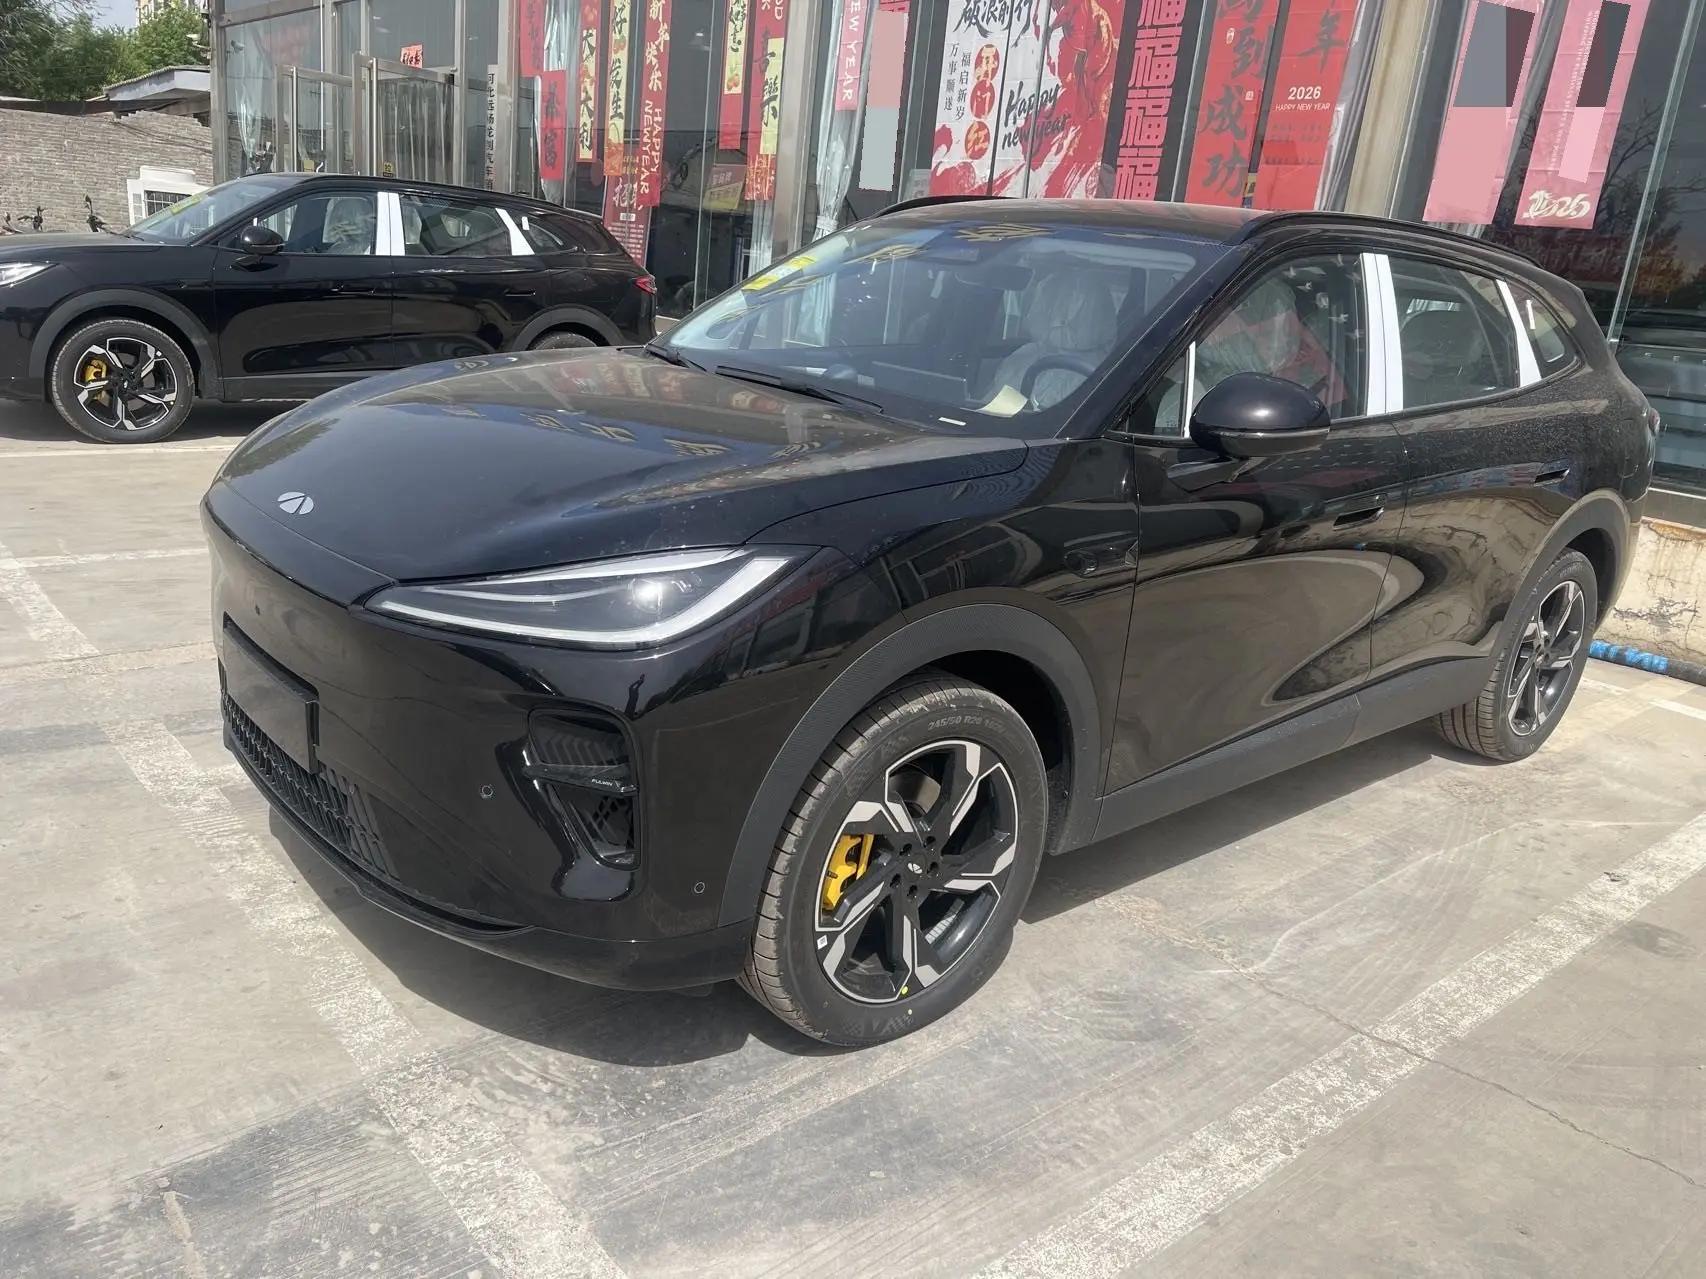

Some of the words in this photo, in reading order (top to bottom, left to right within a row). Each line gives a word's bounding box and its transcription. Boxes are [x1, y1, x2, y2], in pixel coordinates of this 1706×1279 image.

[842, 40, 858, 101] YEAR
[955, 52, 972, 121] 福启新岁
[1288, 86, 1322, 100] 2026
[1004, 81, 1061, 127] Happy
[1296, 103, 1313, 111] NEW
[1313, 102, 1331, 111] YEAR
[651, 108, 662, 172] HAPPY
